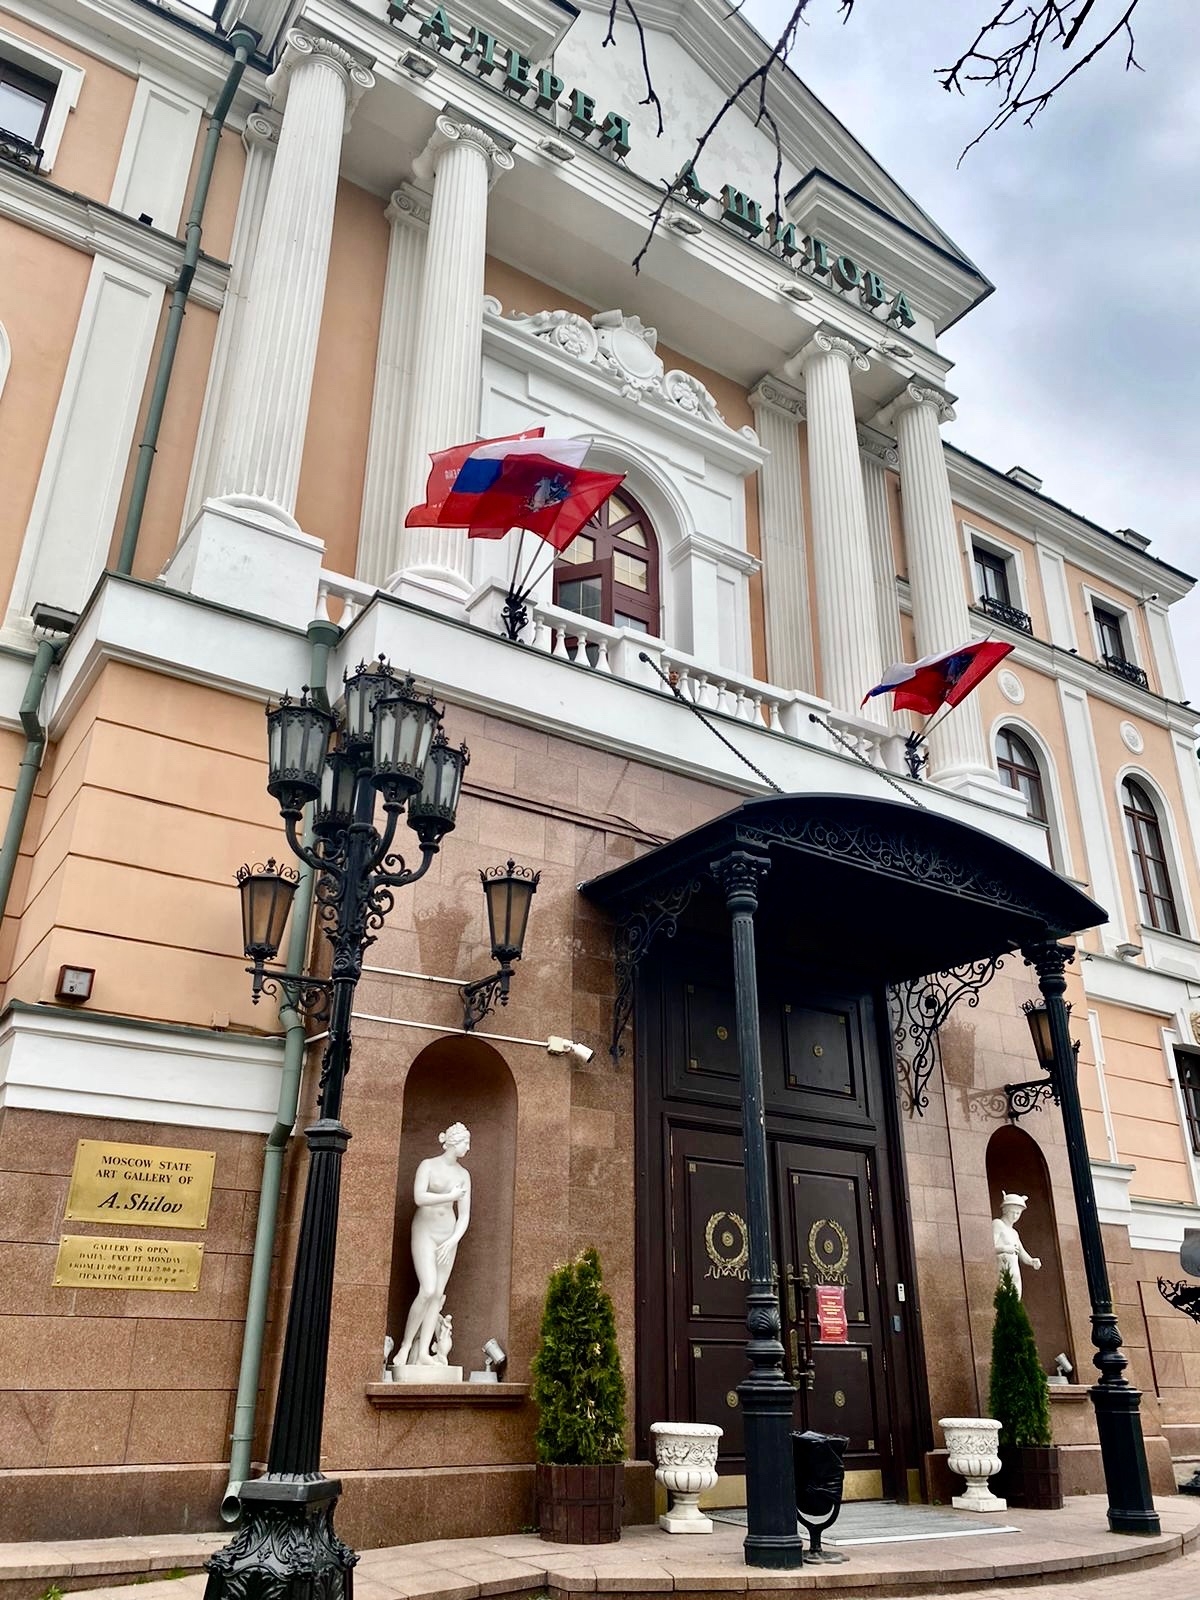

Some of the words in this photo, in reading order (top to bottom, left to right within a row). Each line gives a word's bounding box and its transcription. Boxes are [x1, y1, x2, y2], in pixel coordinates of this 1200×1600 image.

[387, 0, 631, 157] АЛЕРЕЯ
[720, 184, 916, 328] ШИЛОВА
[102, 1155, 153, 1168] MOSCOW
[159, 1160, 192, 1172] STATE
[96, 1169, 118, 1179] ART
[123, 1171, 173, 1184] GALLERY
[178, 1175, 194, 1185] OF
[97, 1191, 120, 1210] A.
[123, 1192, 183, 1214] Shilov
[93, 1243, 129, 1252] GALLERY
[134, 1245, 143, 1253] IS
[147, 1246, 169, 1254] OPEN
